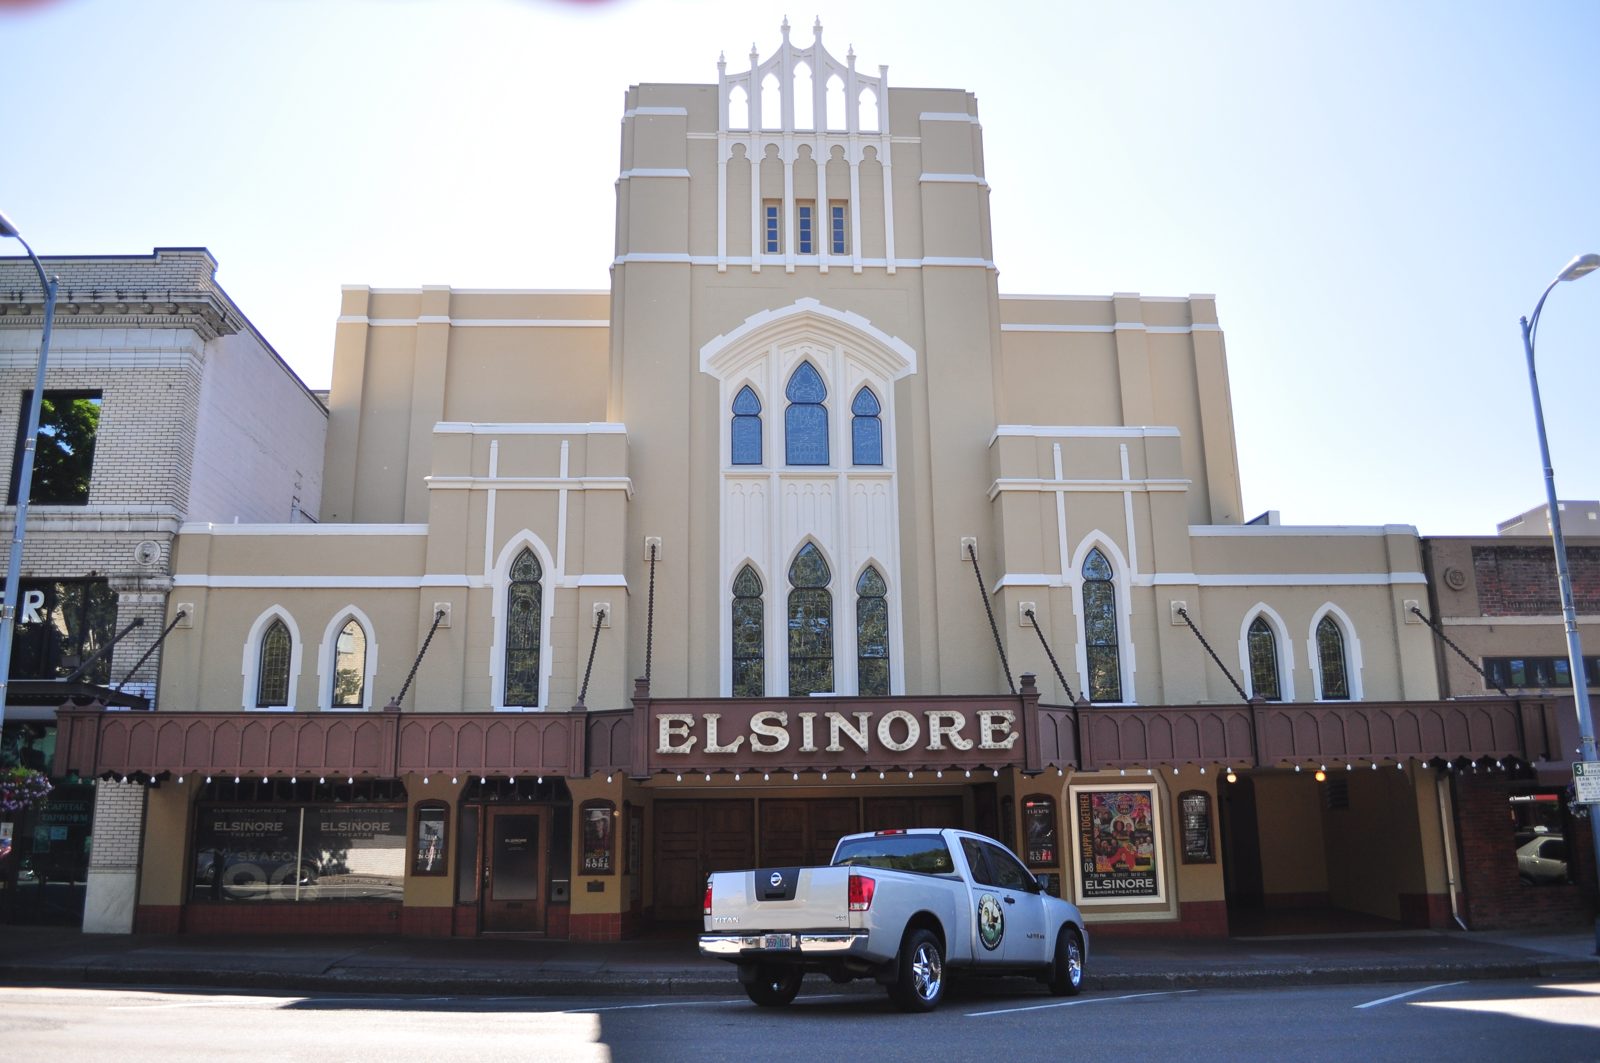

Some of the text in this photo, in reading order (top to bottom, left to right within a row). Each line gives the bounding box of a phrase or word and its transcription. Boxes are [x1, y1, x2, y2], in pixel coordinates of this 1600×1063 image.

[655, 710, 1019, 754] ELSINORE
[1576, 764, 1583, 775] 3
[1081, 794, 1091, 831] TOGETHER
[213, 822, 284, 831] ELSINORE
[320, 822, 391, 831] ELSINORE
[1082, 833, 1093, 858] HAPPY
[1084, 863, 1094, 872] 08
[1085, 879, 1154, 889] ELSINORE
